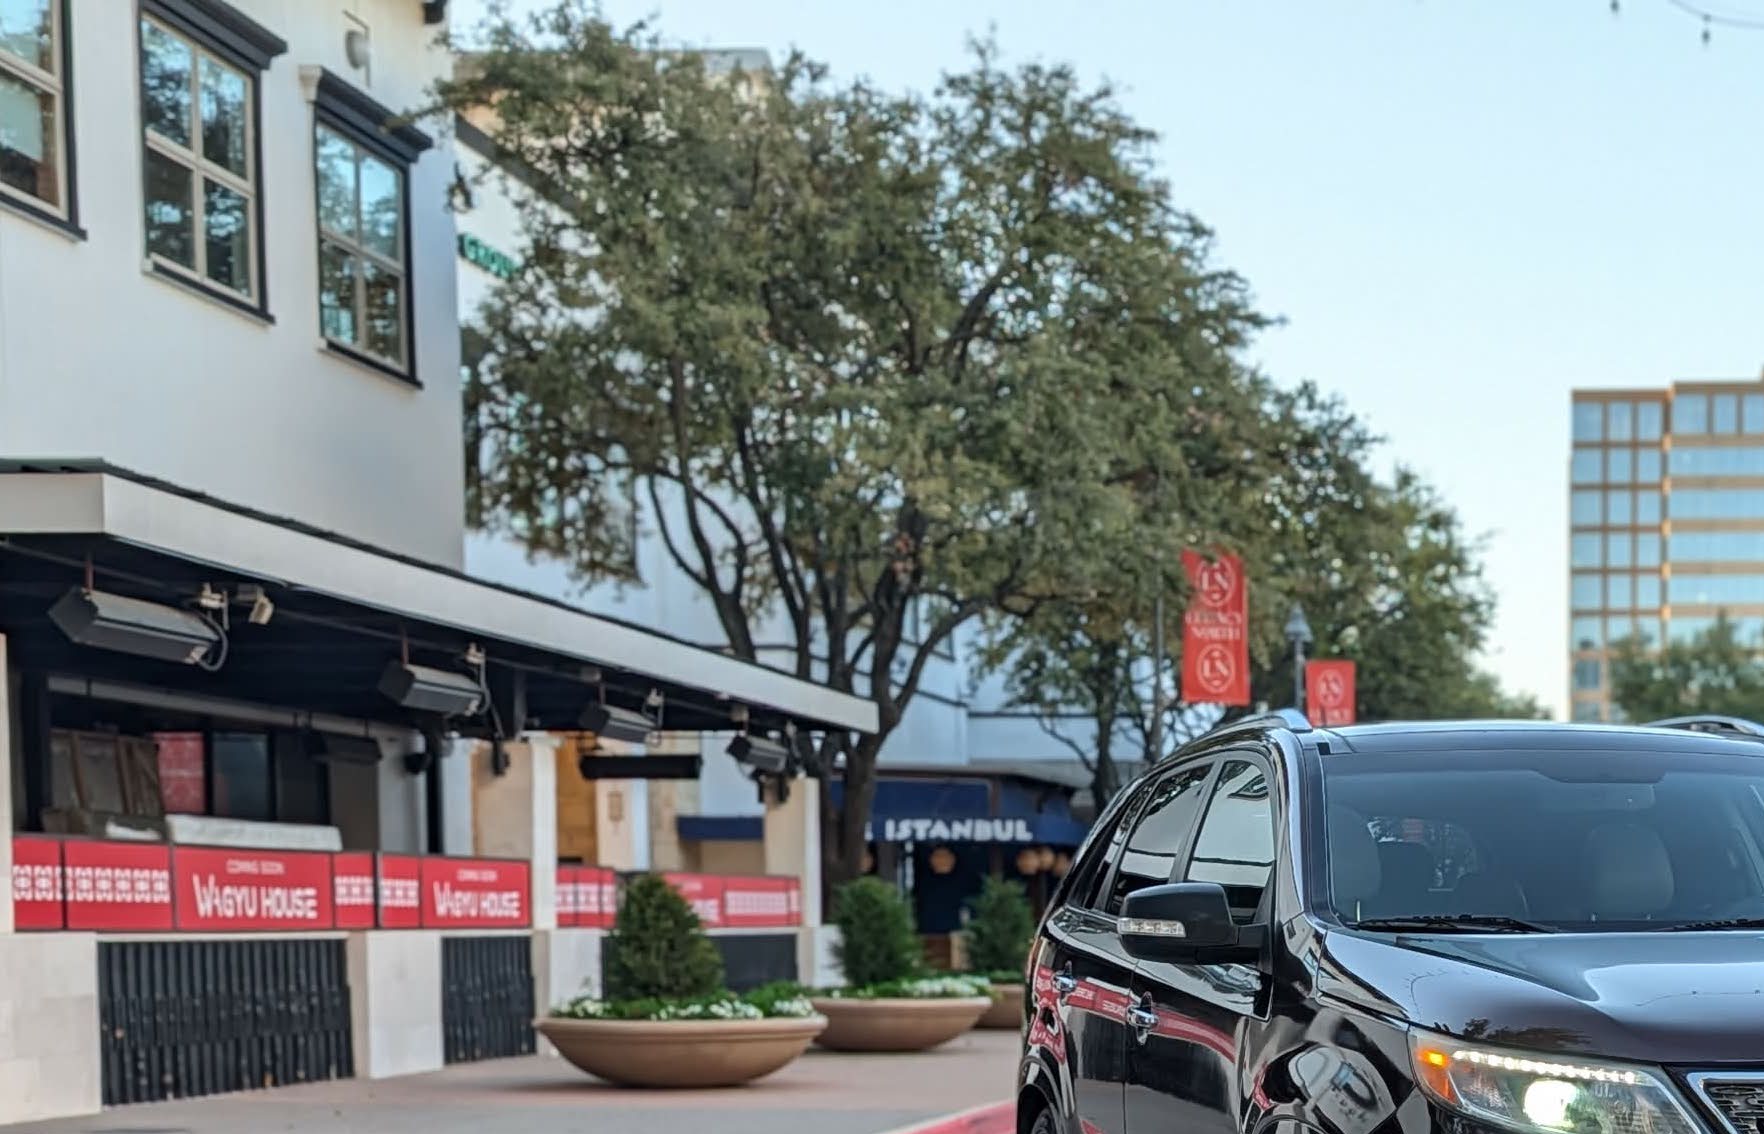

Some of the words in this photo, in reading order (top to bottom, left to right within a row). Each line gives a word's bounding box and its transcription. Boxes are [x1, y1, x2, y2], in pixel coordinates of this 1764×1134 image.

[884, 818, 1034, 842] ISTANBUL
[192, 873, 258, 918] WAGYU
[260, 886, 318, 919] HOUSE
[479, 890, 520, 918] HOUSE
